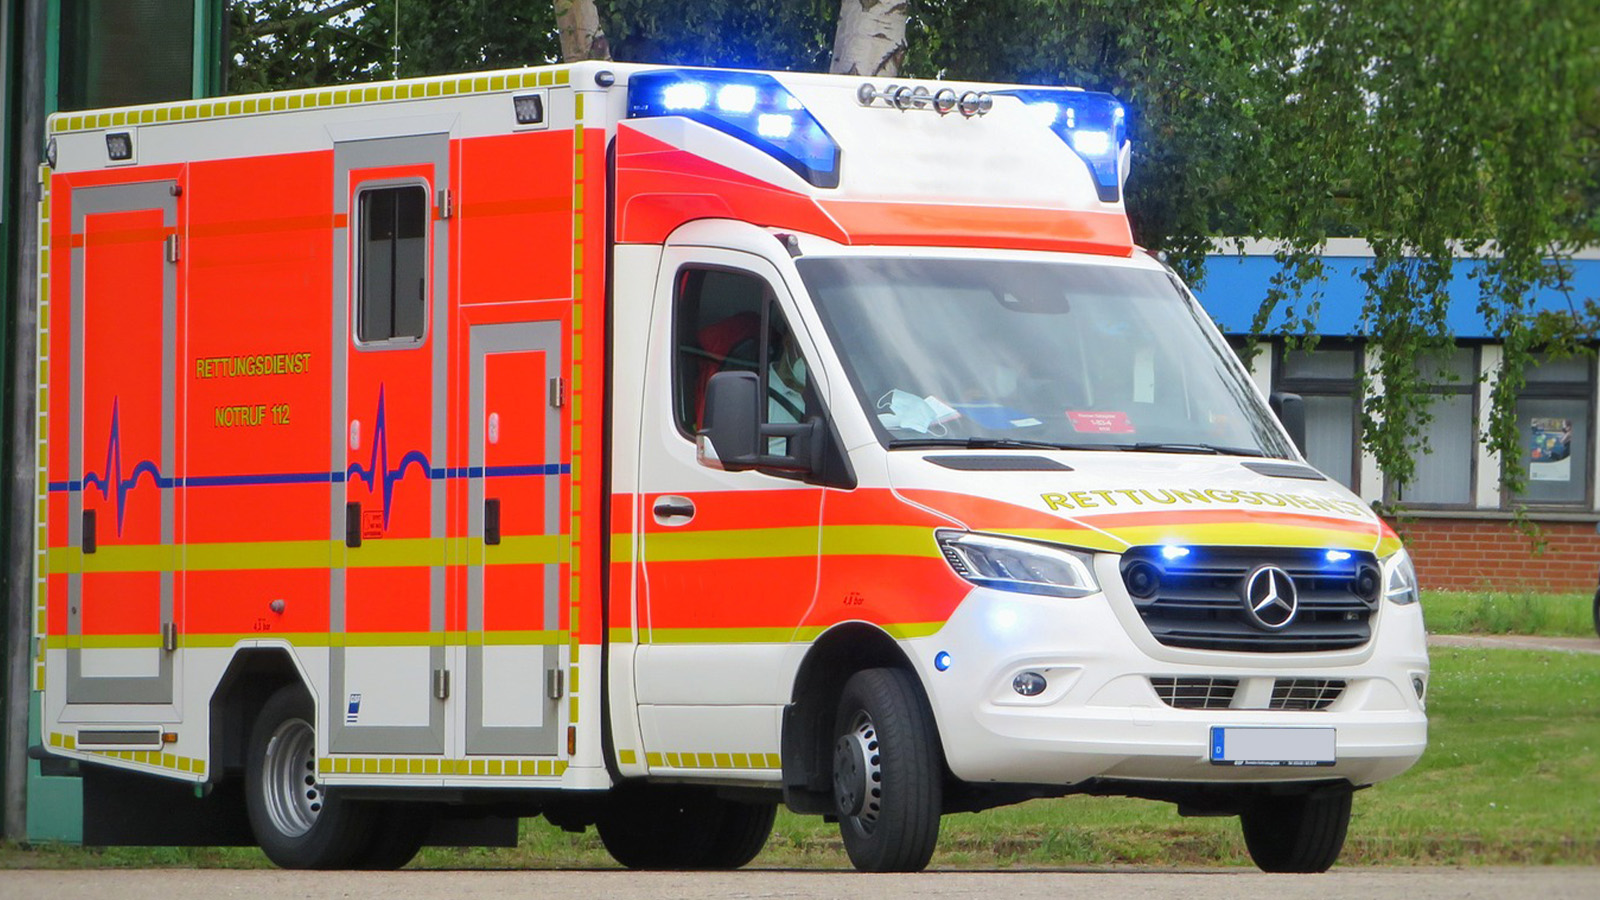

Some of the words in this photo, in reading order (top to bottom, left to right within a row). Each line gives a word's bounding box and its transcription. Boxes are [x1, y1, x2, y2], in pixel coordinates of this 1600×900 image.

[195, 352, 311, 378] RETTUNGSDIENST
[215, 405, 266, 427] NOTRUF
[271, 403, 290, 424] 112
[1041, 488, 1374, 519] RETTUNGSDIENST
[1215, 746, 1222, 754] D
